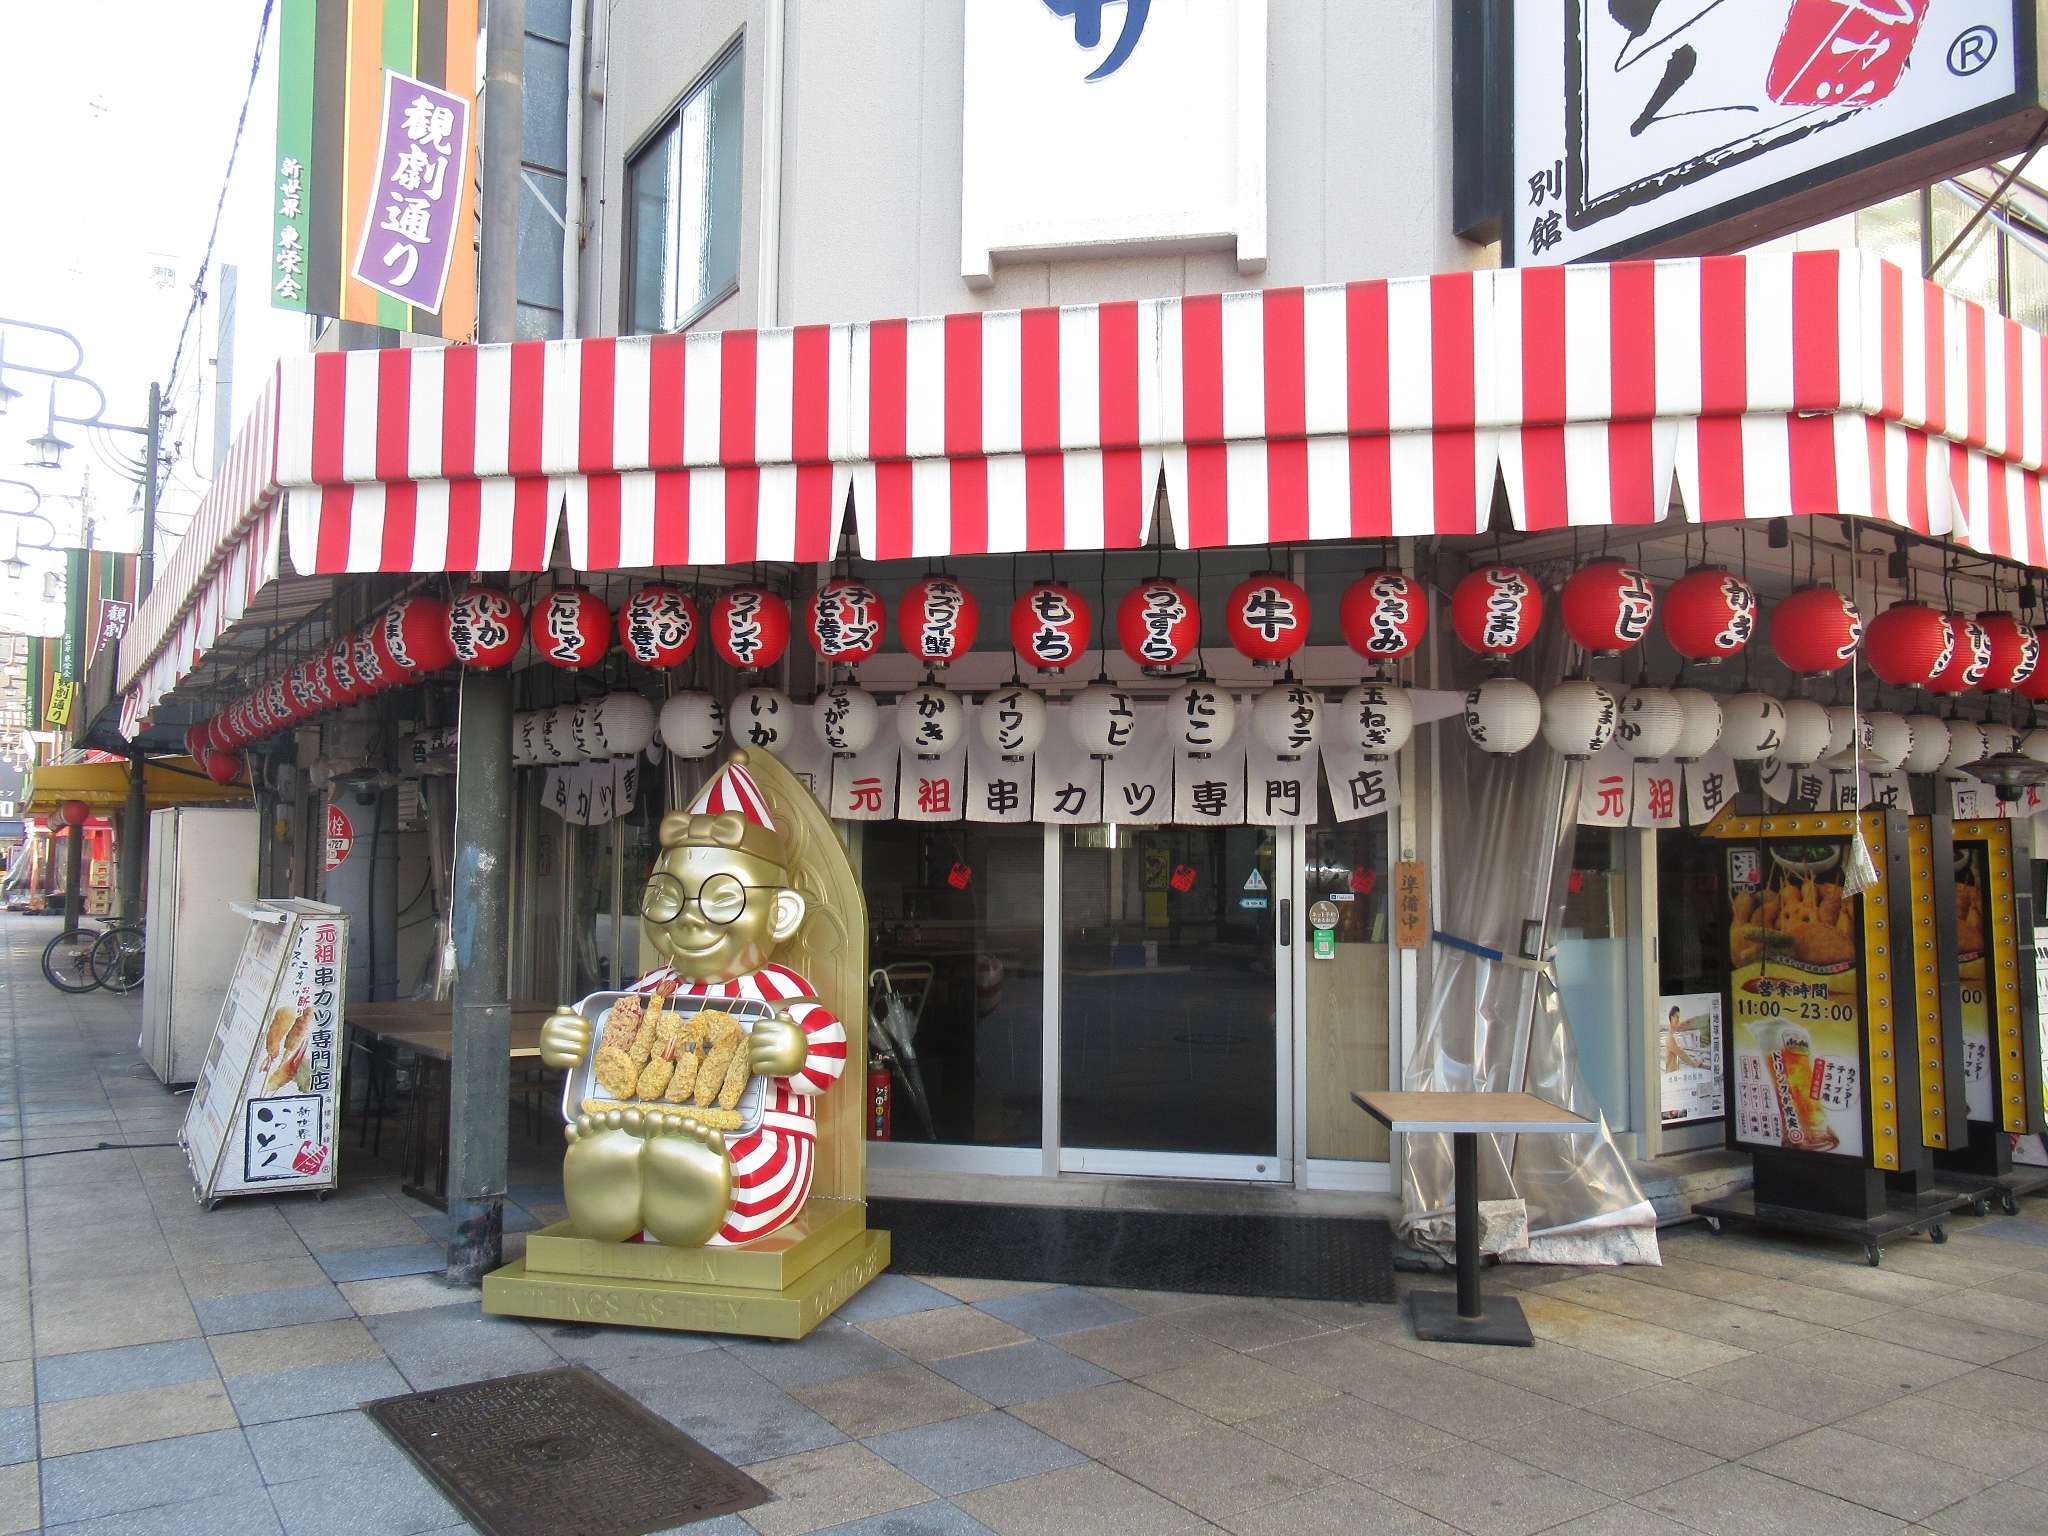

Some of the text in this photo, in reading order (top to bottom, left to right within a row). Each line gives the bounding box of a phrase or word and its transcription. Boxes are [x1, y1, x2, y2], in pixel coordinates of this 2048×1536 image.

[380, 94, 455, 287] 観劇通り
[1526, 160, 1563, 254] 別館
[274, 156, 305, 301] 新世界 東栄会
[477, 592, 509, 648] いか
[547, 591, 585, 662] こんにゃく
[658, 592, 692, 649] えび
[844, 587, 878, 650] チーズ
[1033, 590, 1073, 661] もち
[1141, 587, 1185, 660] うずら
[1244, 588, 1296, 641] 牛
[1368, 574, 1409, 652] ささみ
[1484, 570, 1528, 647] しゅうまい
[1616, 569, 1653, 641] エビ
[749, 694, 780, 747] いか
[823, 687, 852, 749] じゃがいも
[914, 693, 946, 747] かき
[997, 691, 1024, 750] イワシ
[1107, 692, 1134, 747] エビ
[1184, 688, 1217, 746] たこ
[1287, 687, 1316, 750] ホタテ
[1358, 686, 1392, 749] 玉ねぎ
[1756, 701, 1784, 753] ハム
[848, 768, 1387, 818] 元祖串カツ専門店
[1401, 873, 1419, 930] 準備中
[309, 922, 338, 1093] 元祖串カツ専門店
[1757, 981, 1829, 1000] 営業時間
